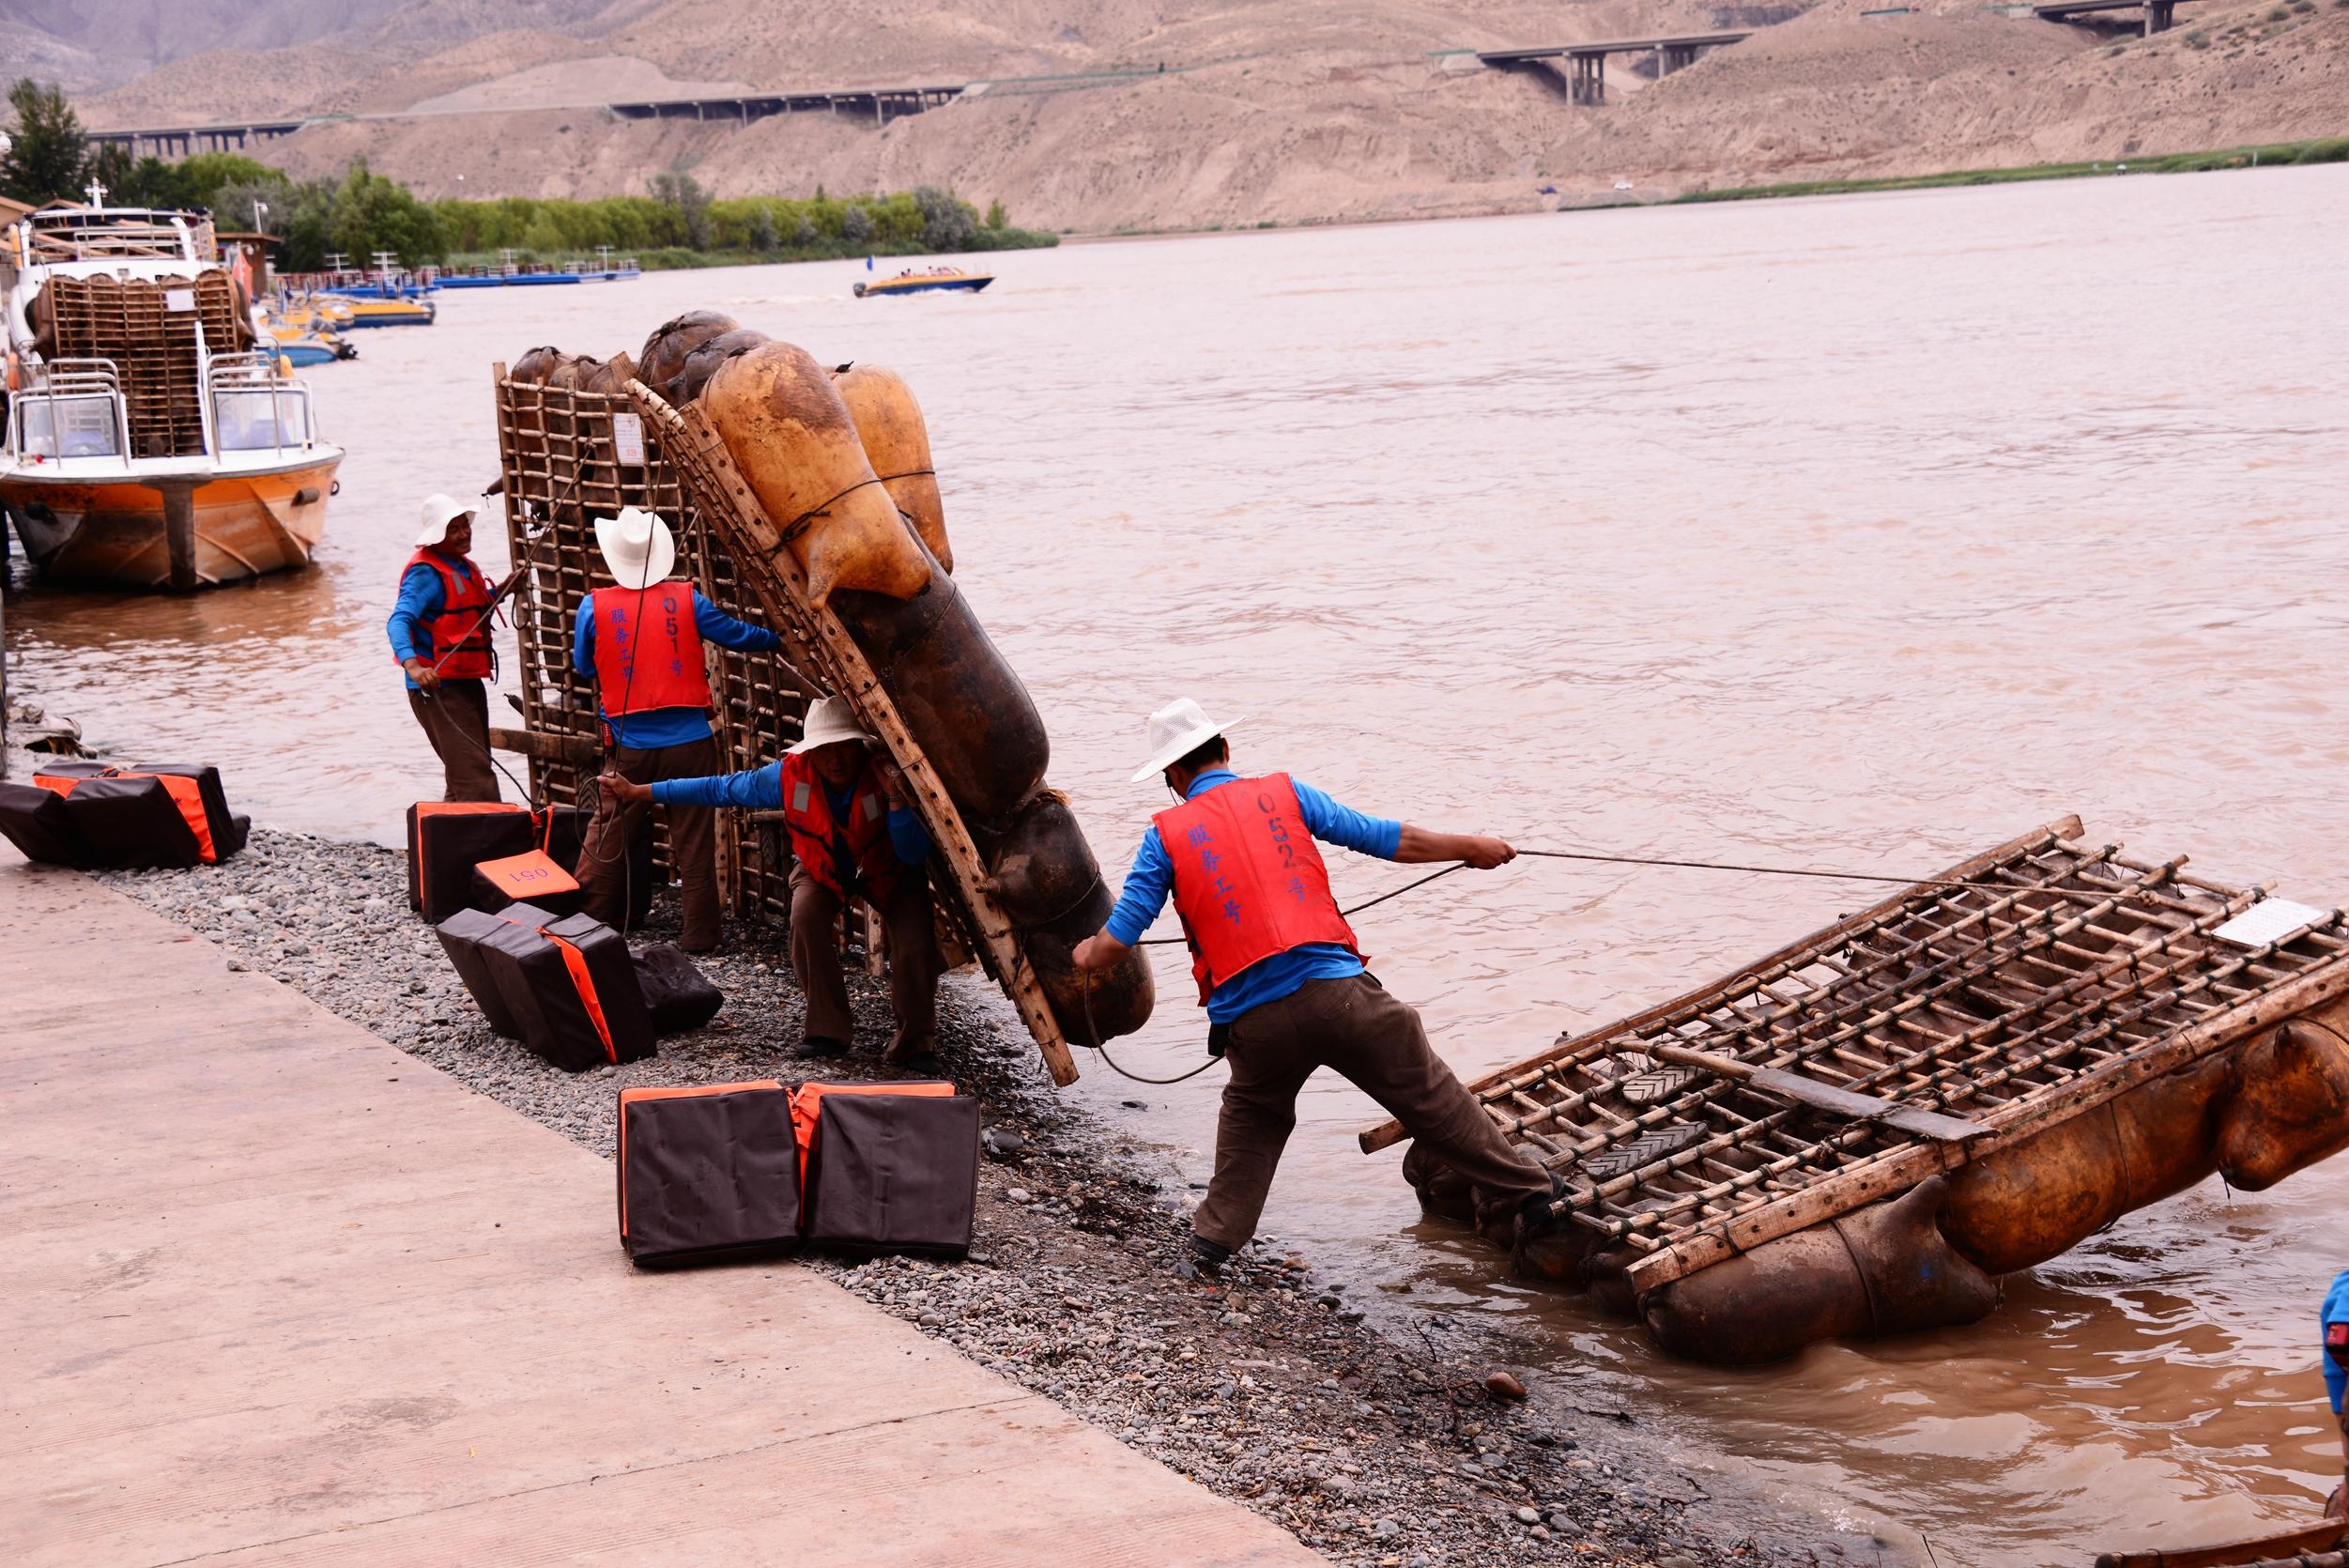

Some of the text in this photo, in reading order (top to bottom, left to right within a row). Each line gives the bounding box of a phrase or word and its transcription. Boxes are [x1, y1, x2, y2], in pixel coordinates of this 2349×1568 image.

[663, 596, 683, 677] 051号
[509, 868, 549, 883] 051
[1187, 822, 1244, 925] 服务工号
[1256, 792, 1308, 902] 052号
